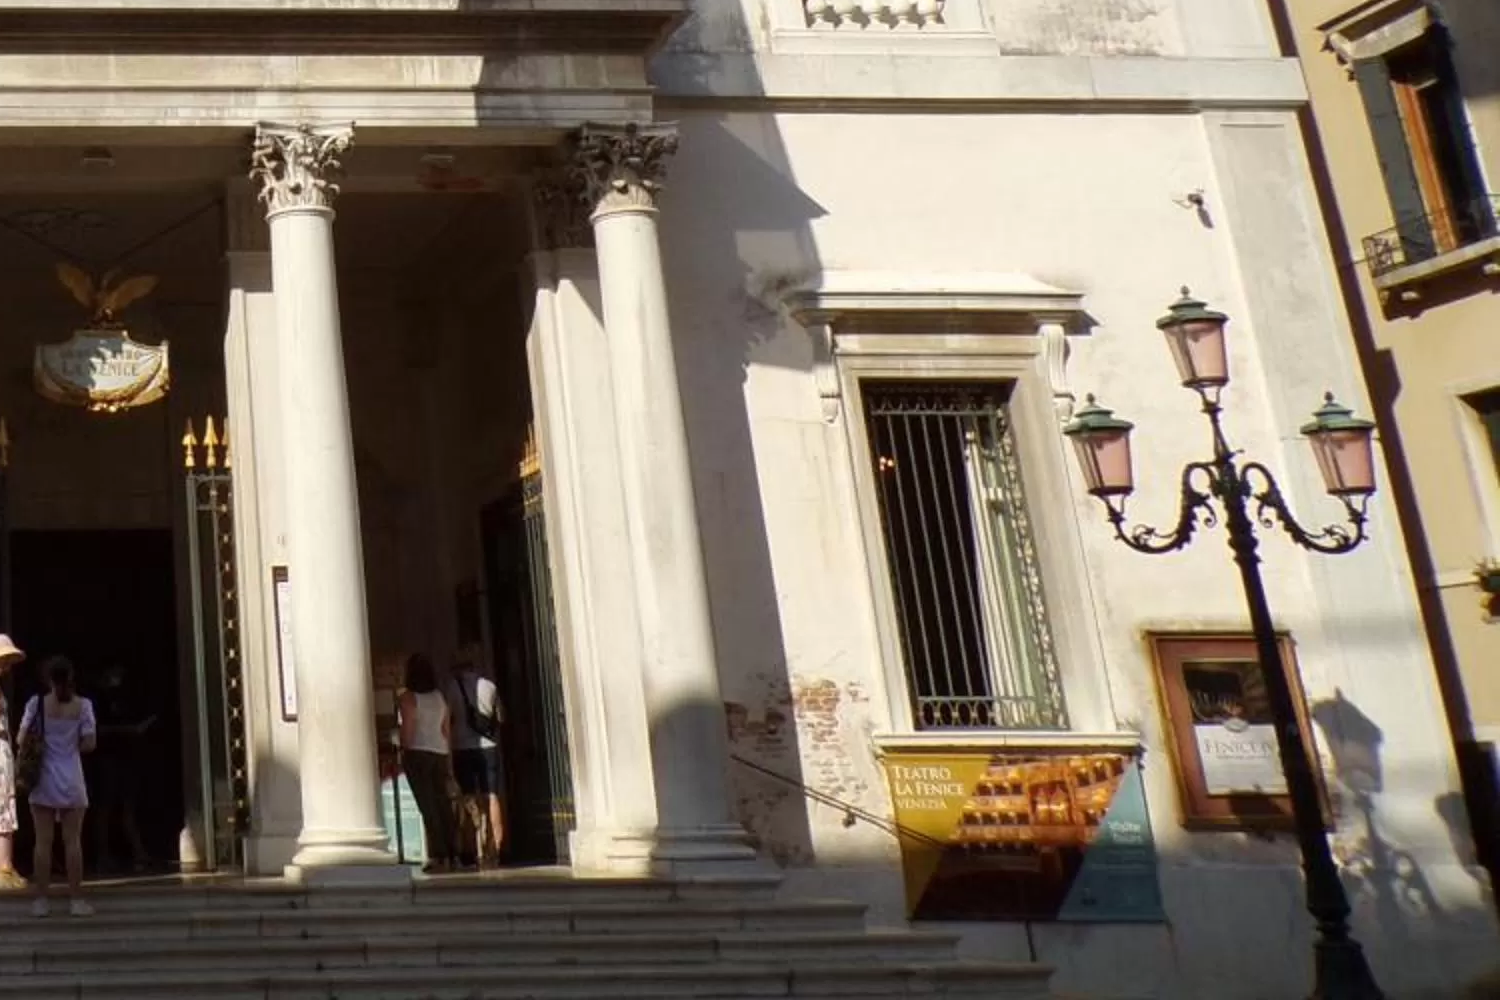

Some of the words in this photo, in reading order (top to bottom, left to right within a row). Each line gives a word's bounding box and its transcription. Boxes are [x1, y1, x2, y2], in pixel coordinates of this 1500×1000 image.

[892, 766, 952, 780] TEATRO
[895, 781, 913, 796] LA
[915, 781, 965, 796] FENICE
[895, 799, 948, 809] VENEZIA
